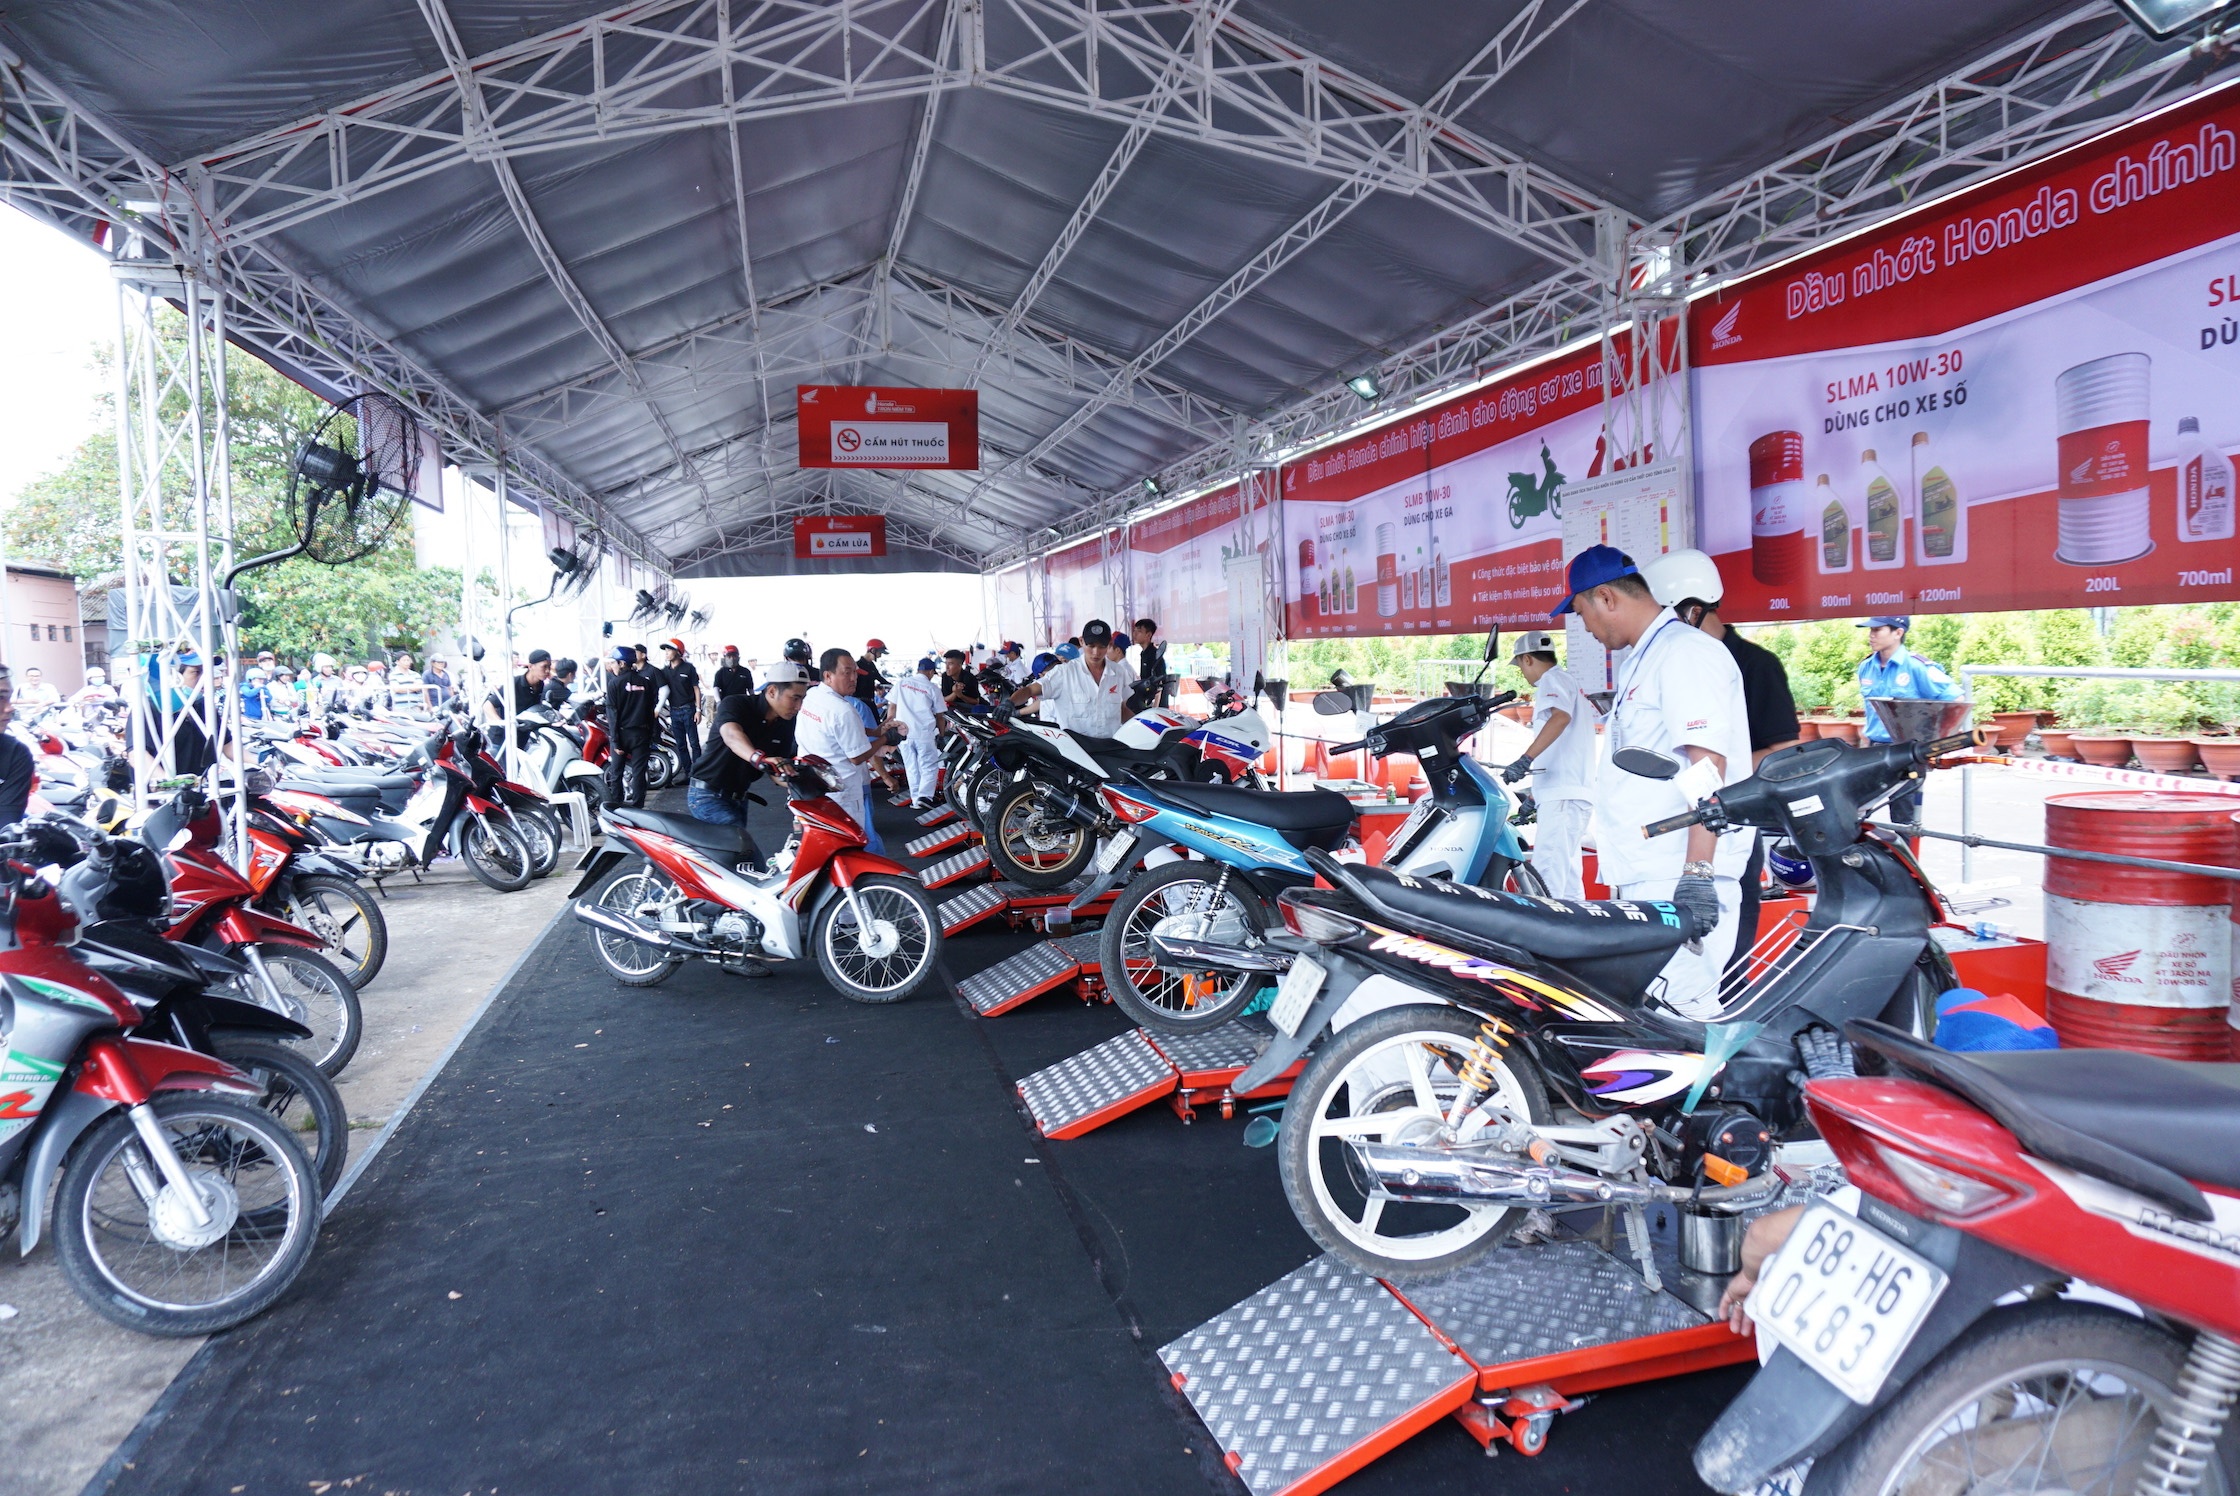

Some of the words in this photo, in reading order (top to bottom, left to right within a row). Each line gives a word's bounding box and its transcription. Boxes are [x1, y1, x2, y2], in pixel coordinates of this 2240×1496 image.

[1787, 271, 1845, 320] Dầu
[1853, 236, 1935, 298] nhớt
[1944, 186, 2078, 266] Honda
[2089, 122, 2236, 214] chính
[1712, 335, 1742, 350] HONDA
[1827, 372, 1879, 403] SLMA
[1886, 350, 1963, 388] 10W-30
[1348, 441, 1378, 470] Honda
[1379, 428, 1409, 458] chính
[1410, 420, 1435, 449] hiệu
[1438, 406, 1470, 439] dành
[1472, 400, 1497, 428] cho
[1500, 386, 1537, 421] động
[1539, 377, 1559, 405] cơ
[1562, 370, 1583, 398] xe
[1586, 350, 1626, 389] my
[1825, 409, 1869, 434] DÙNG
[1875, 400, 1910, 422] CHO
[1916, 393, 1937, 414] XE
[1943, 380, 1967, 408] SỐ
[865, 436, 887, 447] CẤM
[891, 437, 908, 447] HÚT
[912, 436, 945, 447] THUỐC
[1405, 490, 1423, 508] SLMB
[1425, 485, 1452, 503] 10W-30
[2190, 466, 2198, 508] HONDA
[1421, 510, 1433, 522] CHO
[1435, 509, 1443, 520] XE
[1445, 506, 1453, 517] GA
[828, 538, 849, 547] CẤM
[852, 537, 869, 547] LỬA
[1551, 558, 1564, 571] độn
[2085, 576, 2121, 592] 200L
[2177, 567, 2232, 586] 700ml
[1504, 590, 1512, 599] 8%
[1543, 588, 1550, 596] so
[1770, 598, 1790, 610] 200L
[1822, 594, 1851, 607] 800ml
[1865, 591, 1903, 604] 1000ml
[1919, 587, 1961, 602] 1200ml
[801, 708, 822, 723] HONDA
[1215, 737, 1240, 748] CBR
[2093, 973, 2143, 984] HONDA
[8, 1074, 51, 1082] HONDA
[1869, 1205, 1909, 1237] HONDA
[1770, 1273, 1876, 1372] 0483
